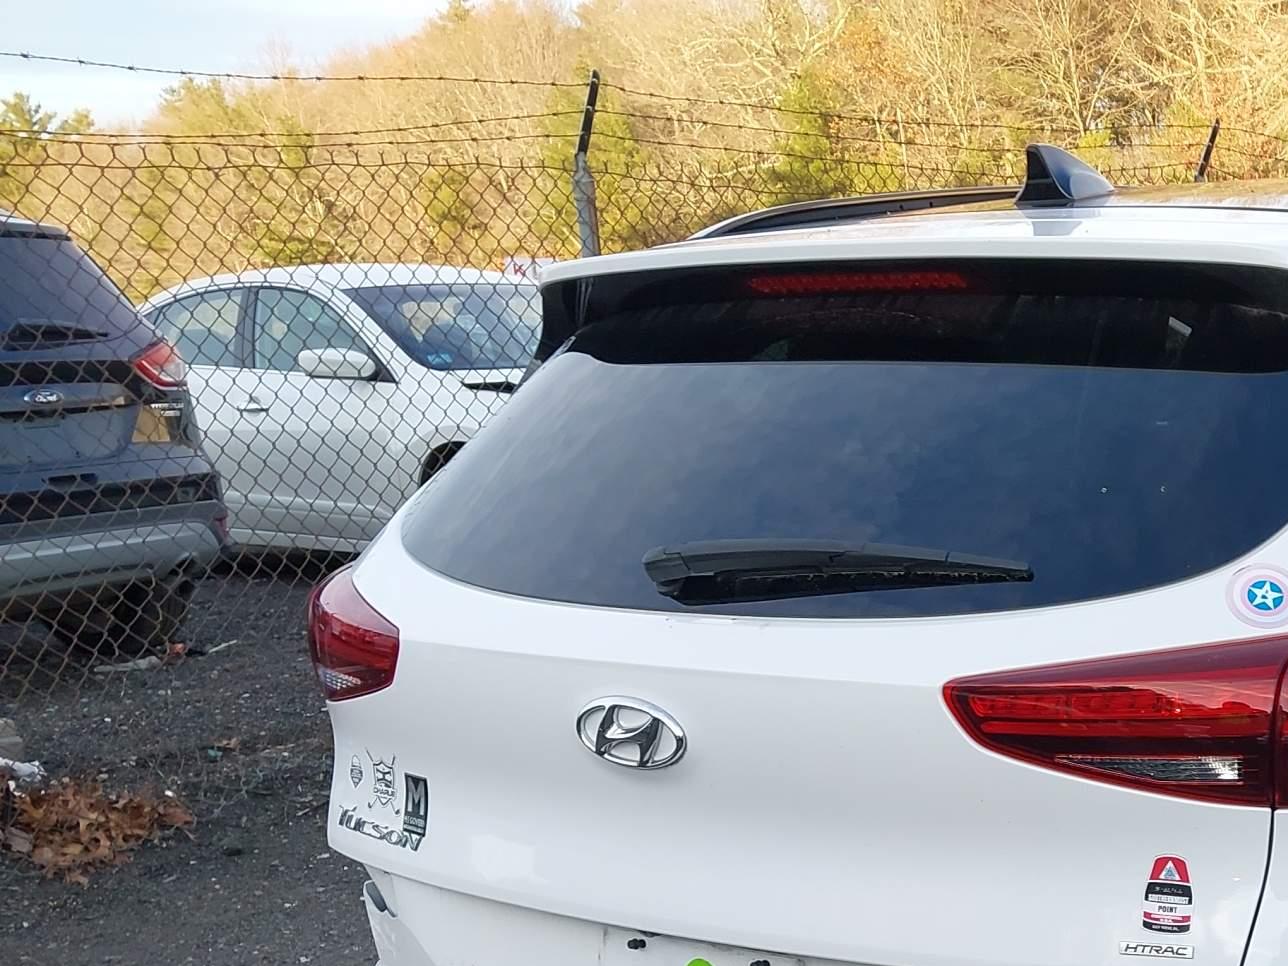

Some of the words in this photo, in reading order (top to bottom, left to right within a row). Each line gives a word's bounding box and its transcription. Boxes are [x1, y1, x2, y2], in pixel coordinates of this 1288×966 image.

[407, 775, 425, 816] M
[338, 804, 424, 852] TUCSON
[1157, 905, 1178, 914] POINT
[1124, 943, 1188, 956] HTRAC
